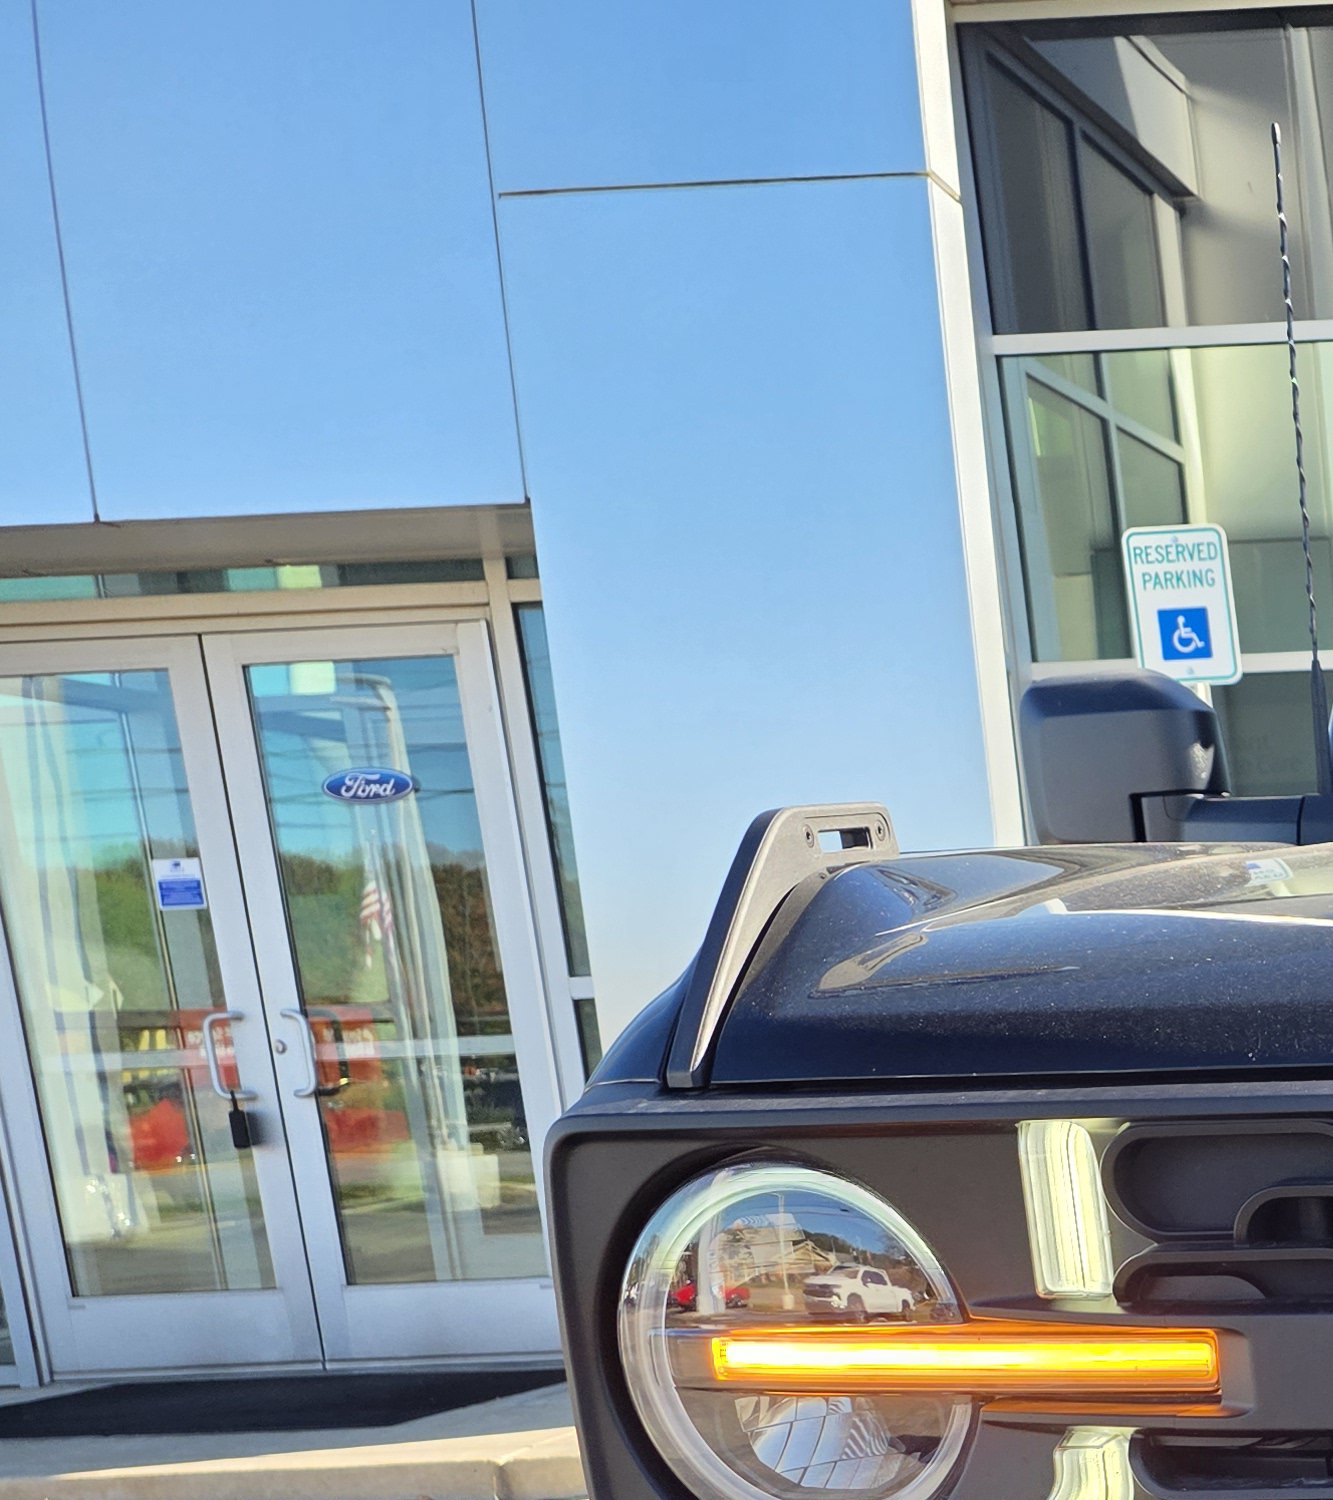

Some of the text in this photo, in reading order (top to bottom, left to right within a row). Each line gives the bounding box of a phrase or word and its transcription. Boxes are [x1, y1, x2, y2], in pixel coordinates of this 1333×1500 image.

[1132, 541, 1219, 565] RESERVED
[1141, 568, 1216, 591] PARKING
[340, 772, 396, 799] Ford
